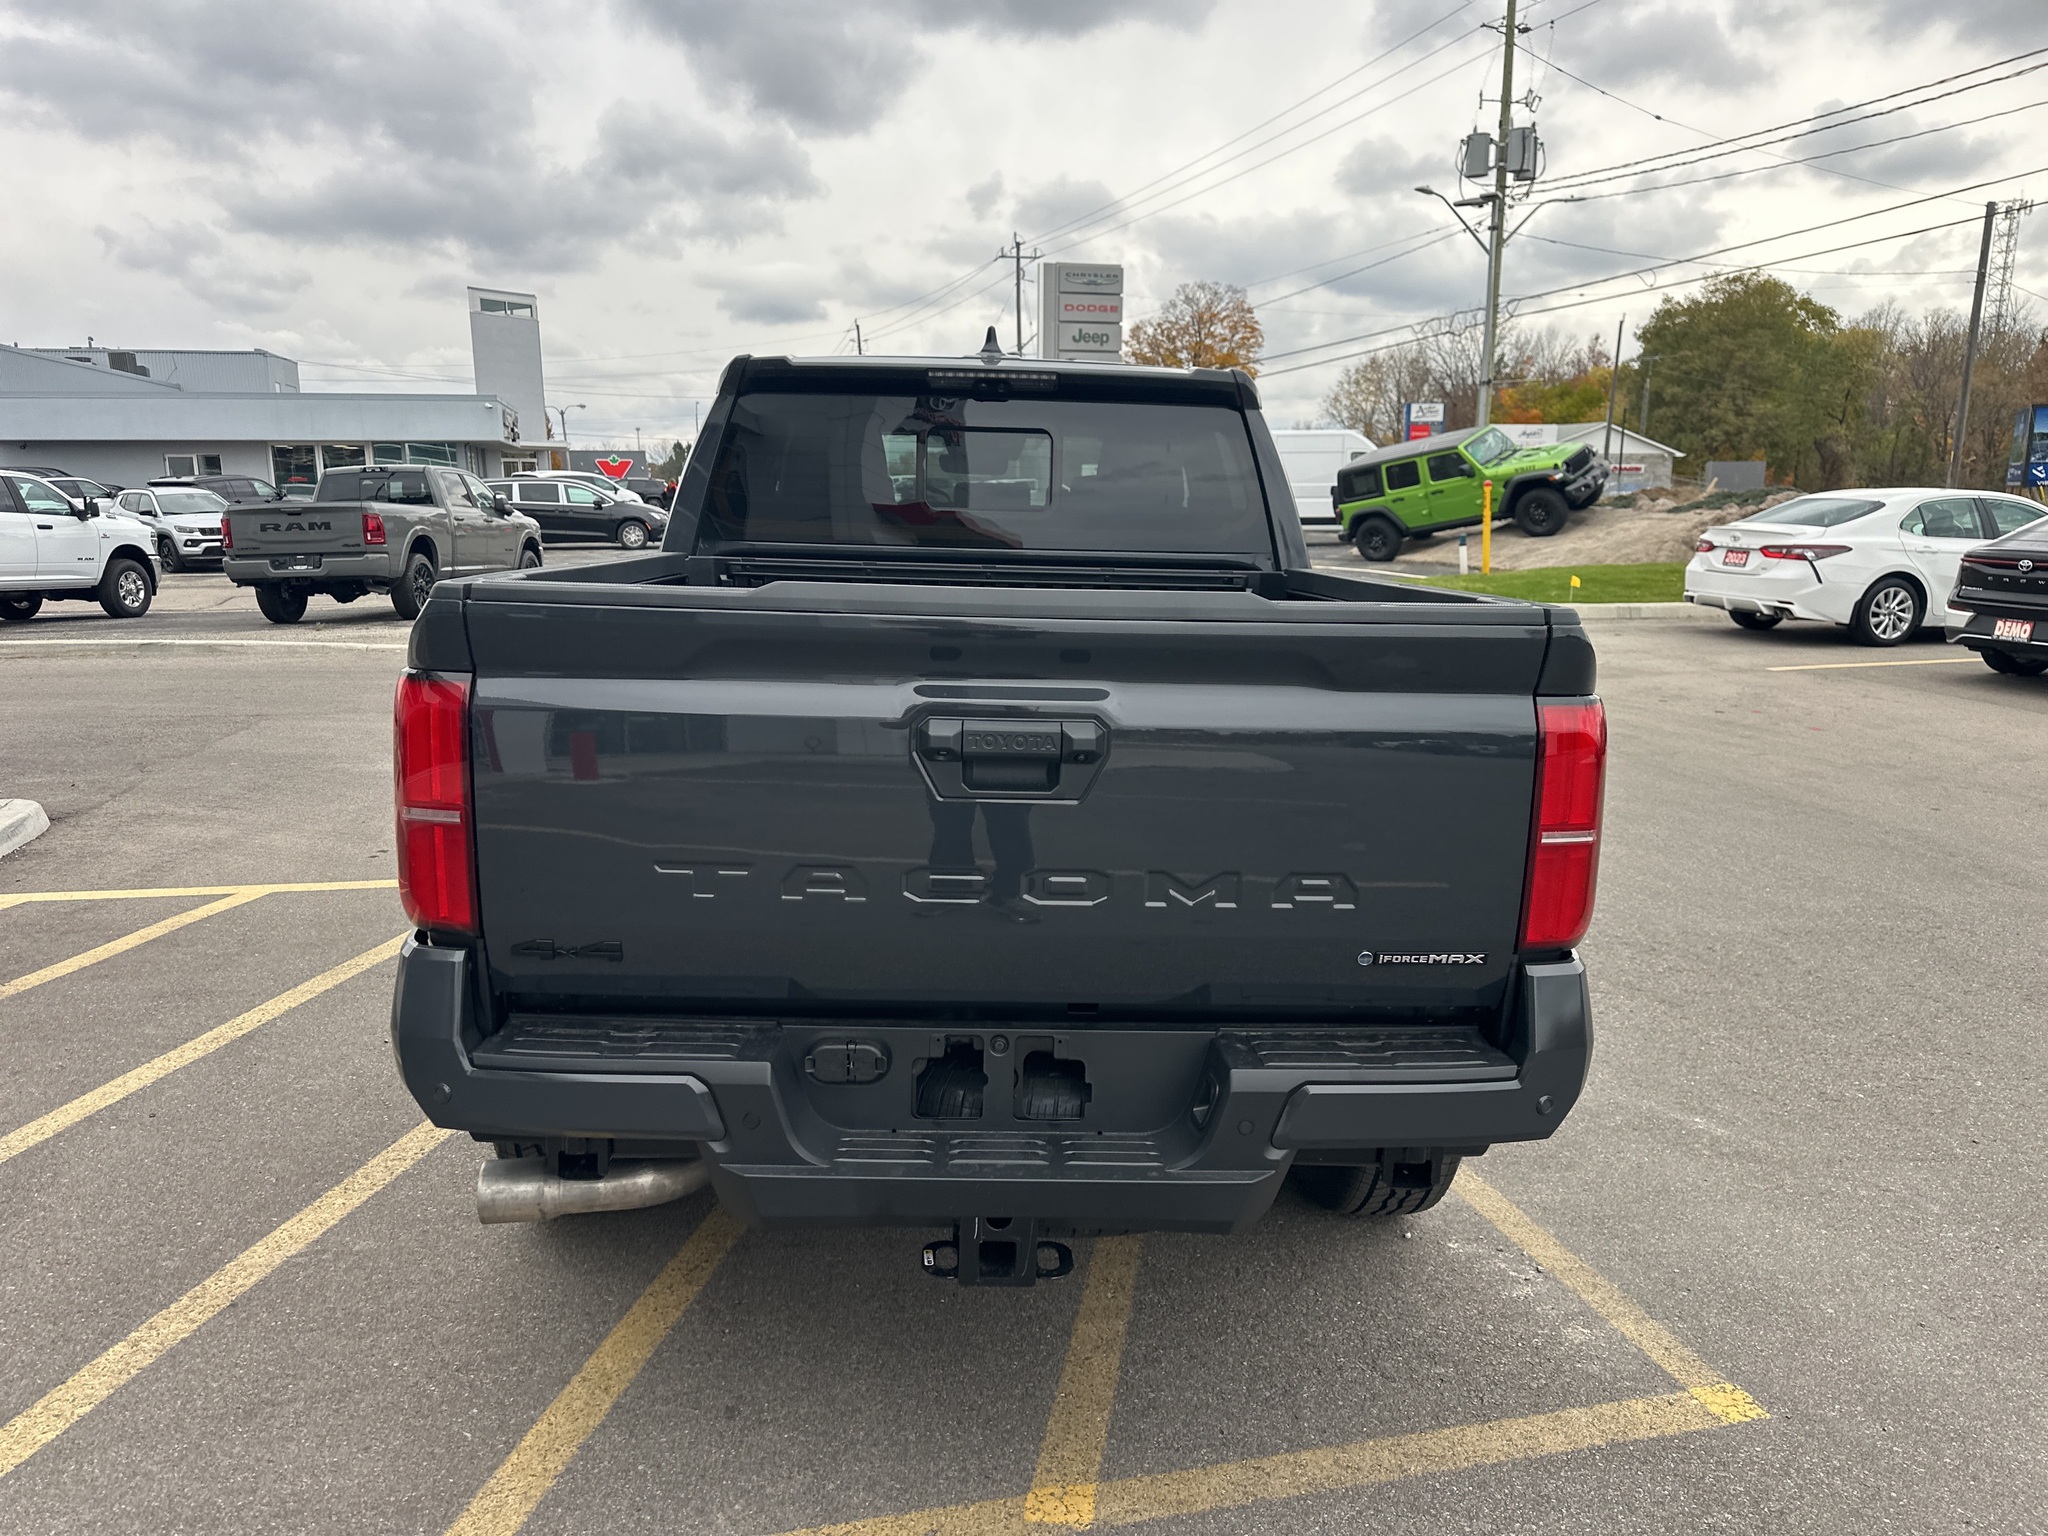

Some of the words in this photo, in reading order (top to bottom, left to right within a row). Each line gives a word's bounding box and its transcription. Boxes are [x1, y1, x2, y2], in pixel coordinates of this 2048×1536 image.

[1065, 271, 1119, 279] CHRYSLER
[1064, 303, 1119, 313] DODGE
[1072, 328, 1110, 346] Jeep
[259, 521, 332, 532] RAM
[1994, 620, 2031, 638] DEMO
[967, 733, 1057, 751] TOYOTA
[652, 861, 1360, 910] TACOMA
